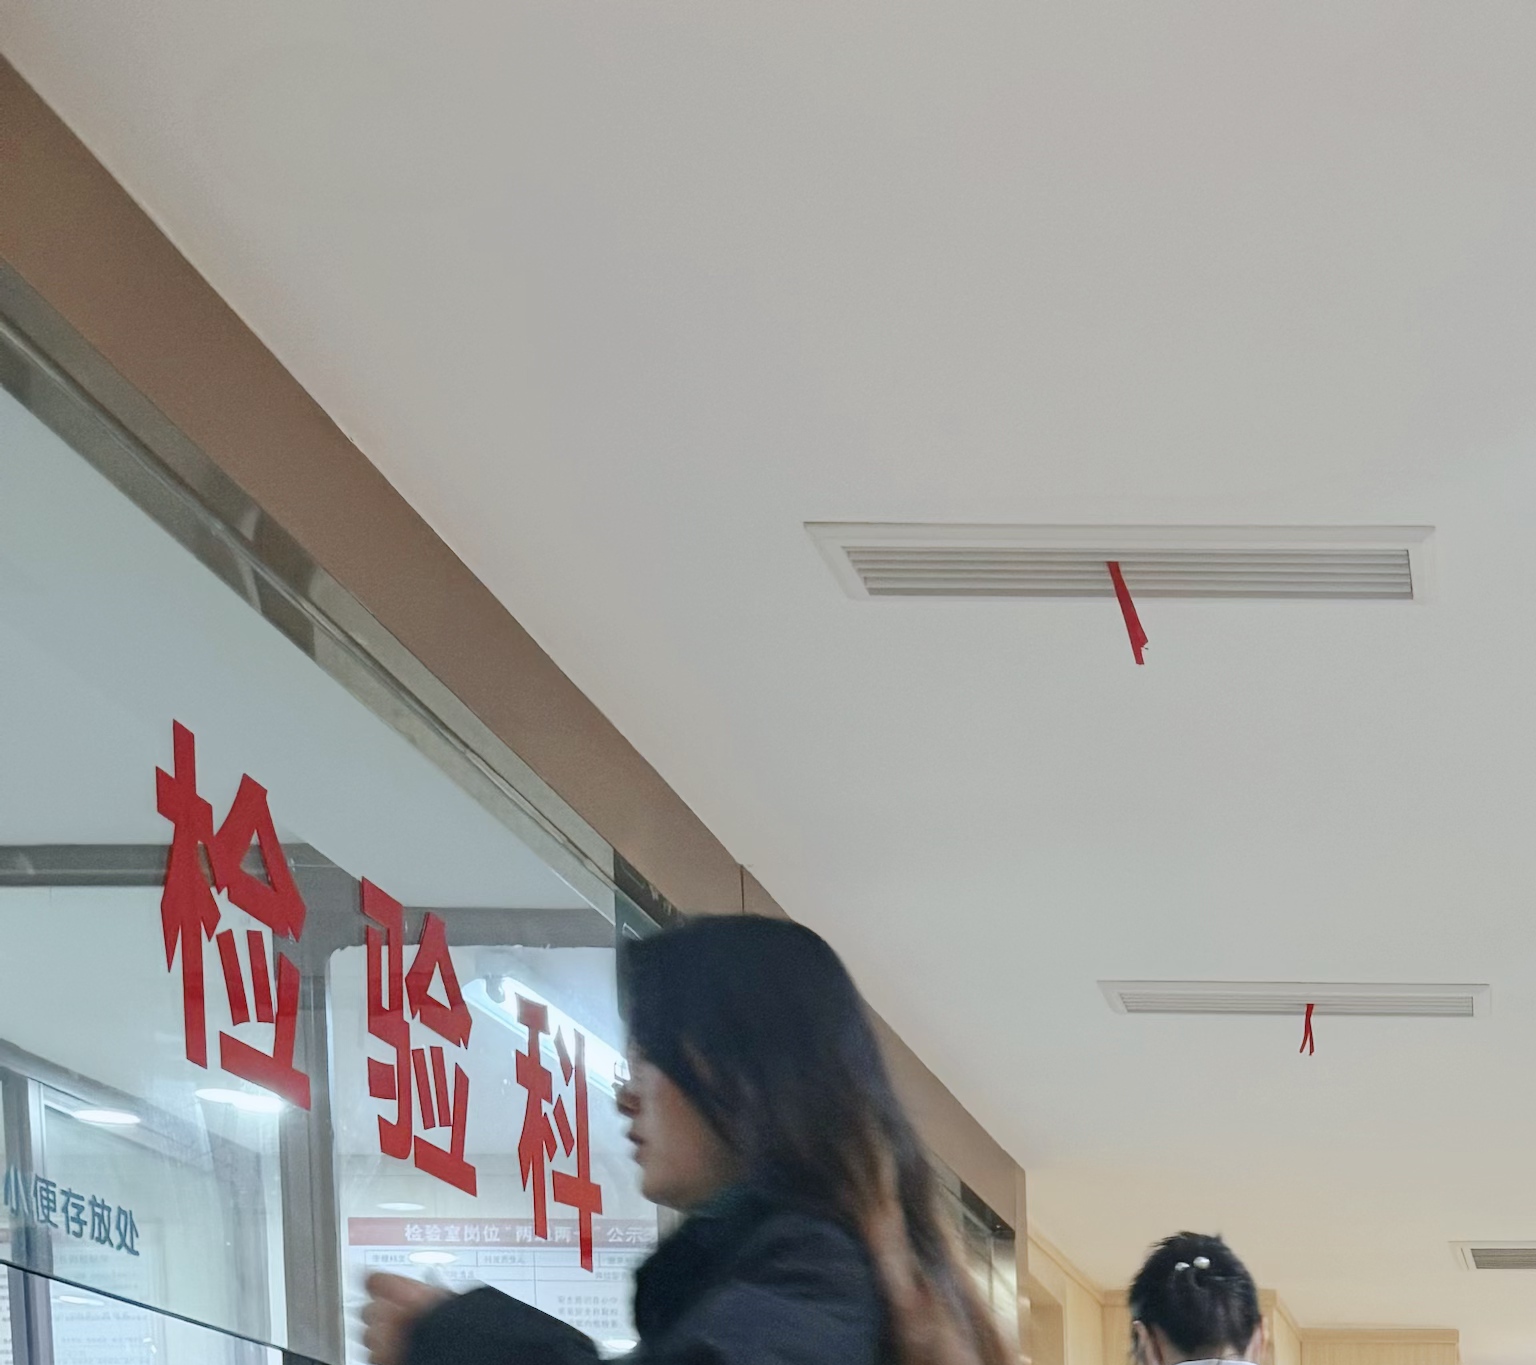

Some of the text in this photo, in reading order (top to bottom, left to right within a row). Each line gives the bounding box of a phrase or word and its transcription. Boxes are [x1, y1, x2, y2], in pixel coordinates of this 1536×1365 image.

[156, 718, 602, 1273] 检验科
[4, 1165, 140, 1257] 小便存放处
